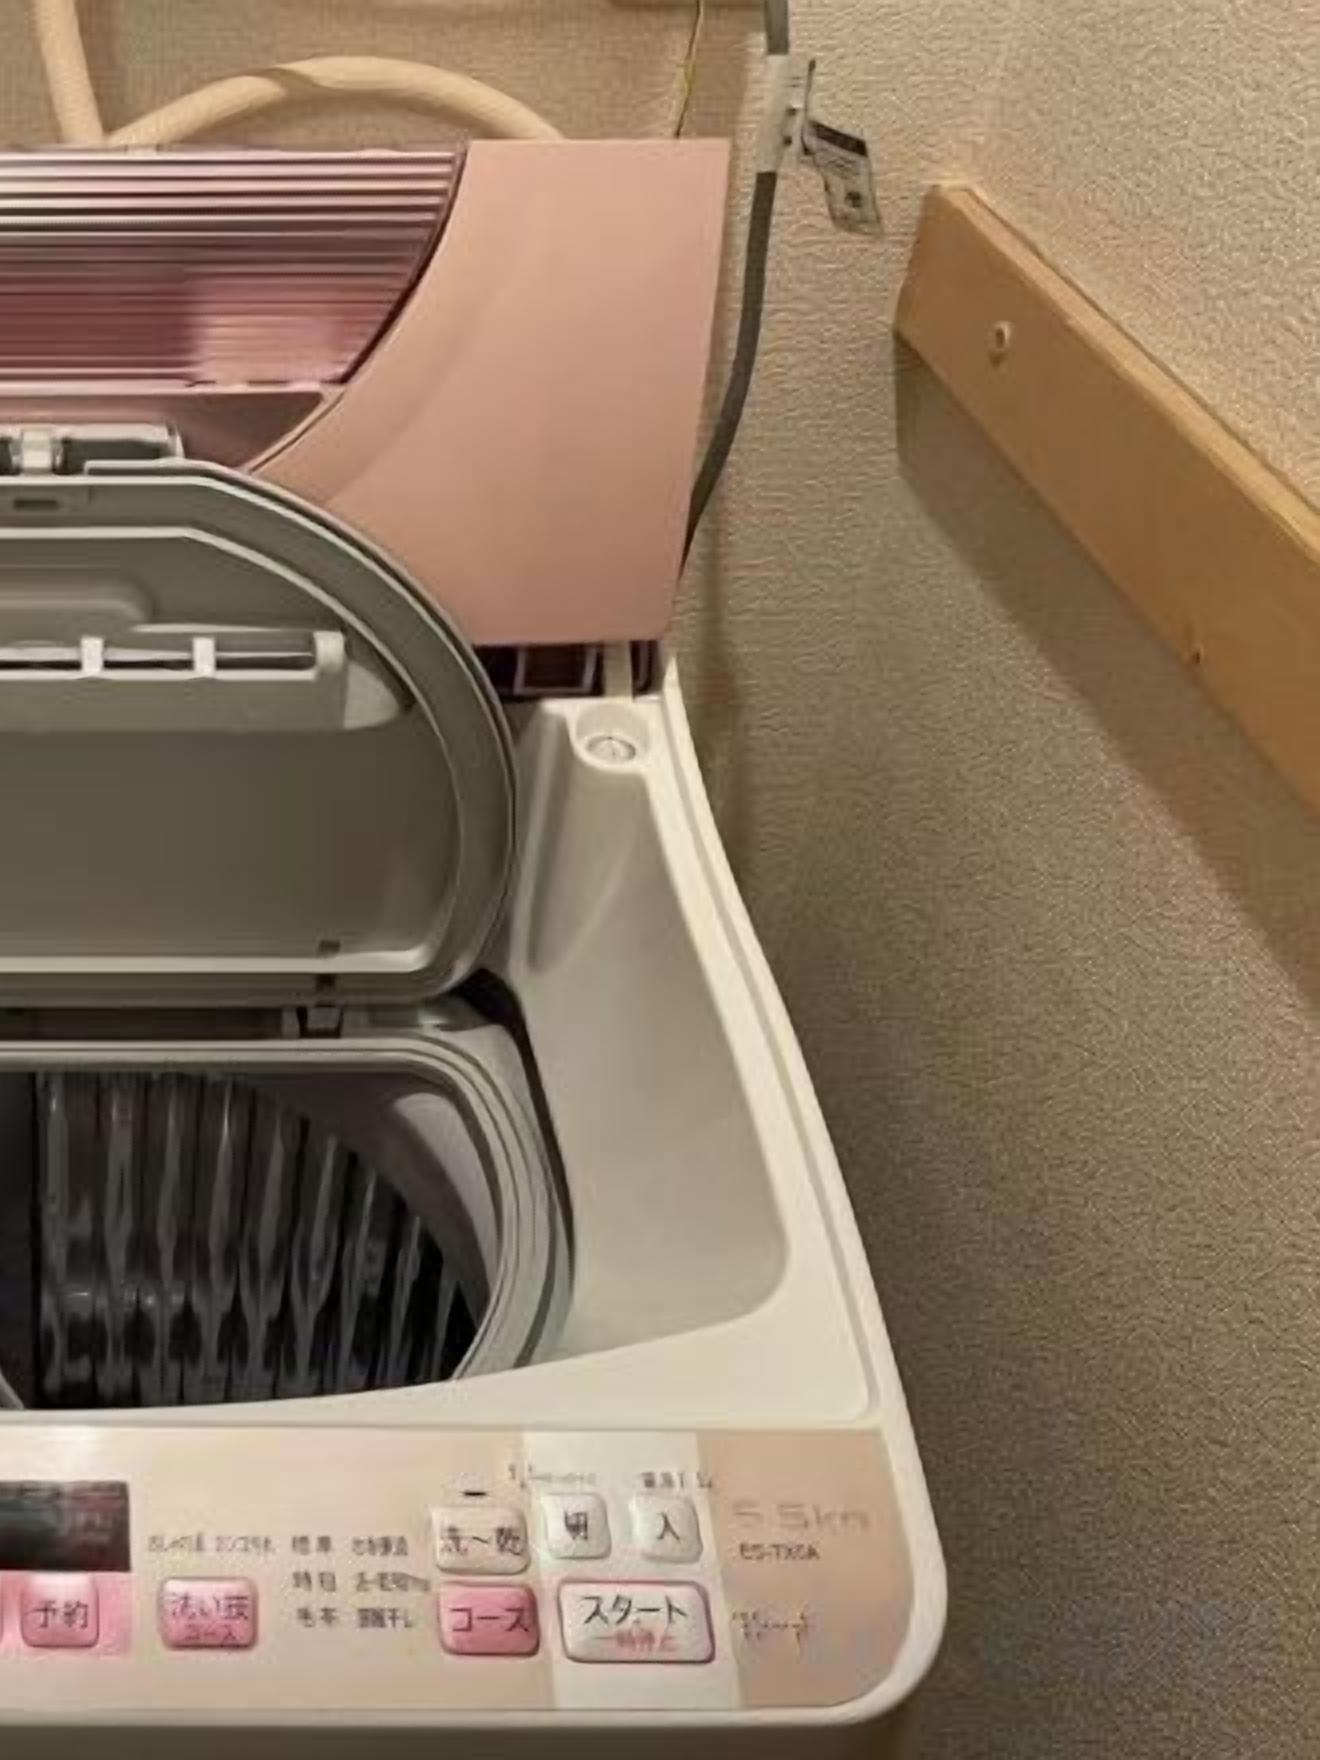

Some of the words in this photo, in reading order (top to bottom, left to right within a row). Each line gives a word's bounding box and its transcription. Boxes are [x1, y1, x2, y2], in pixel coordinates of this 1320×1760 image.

[450, 1606, 530, 1633] コース
[581, 1593, 690, 1625] スタート
